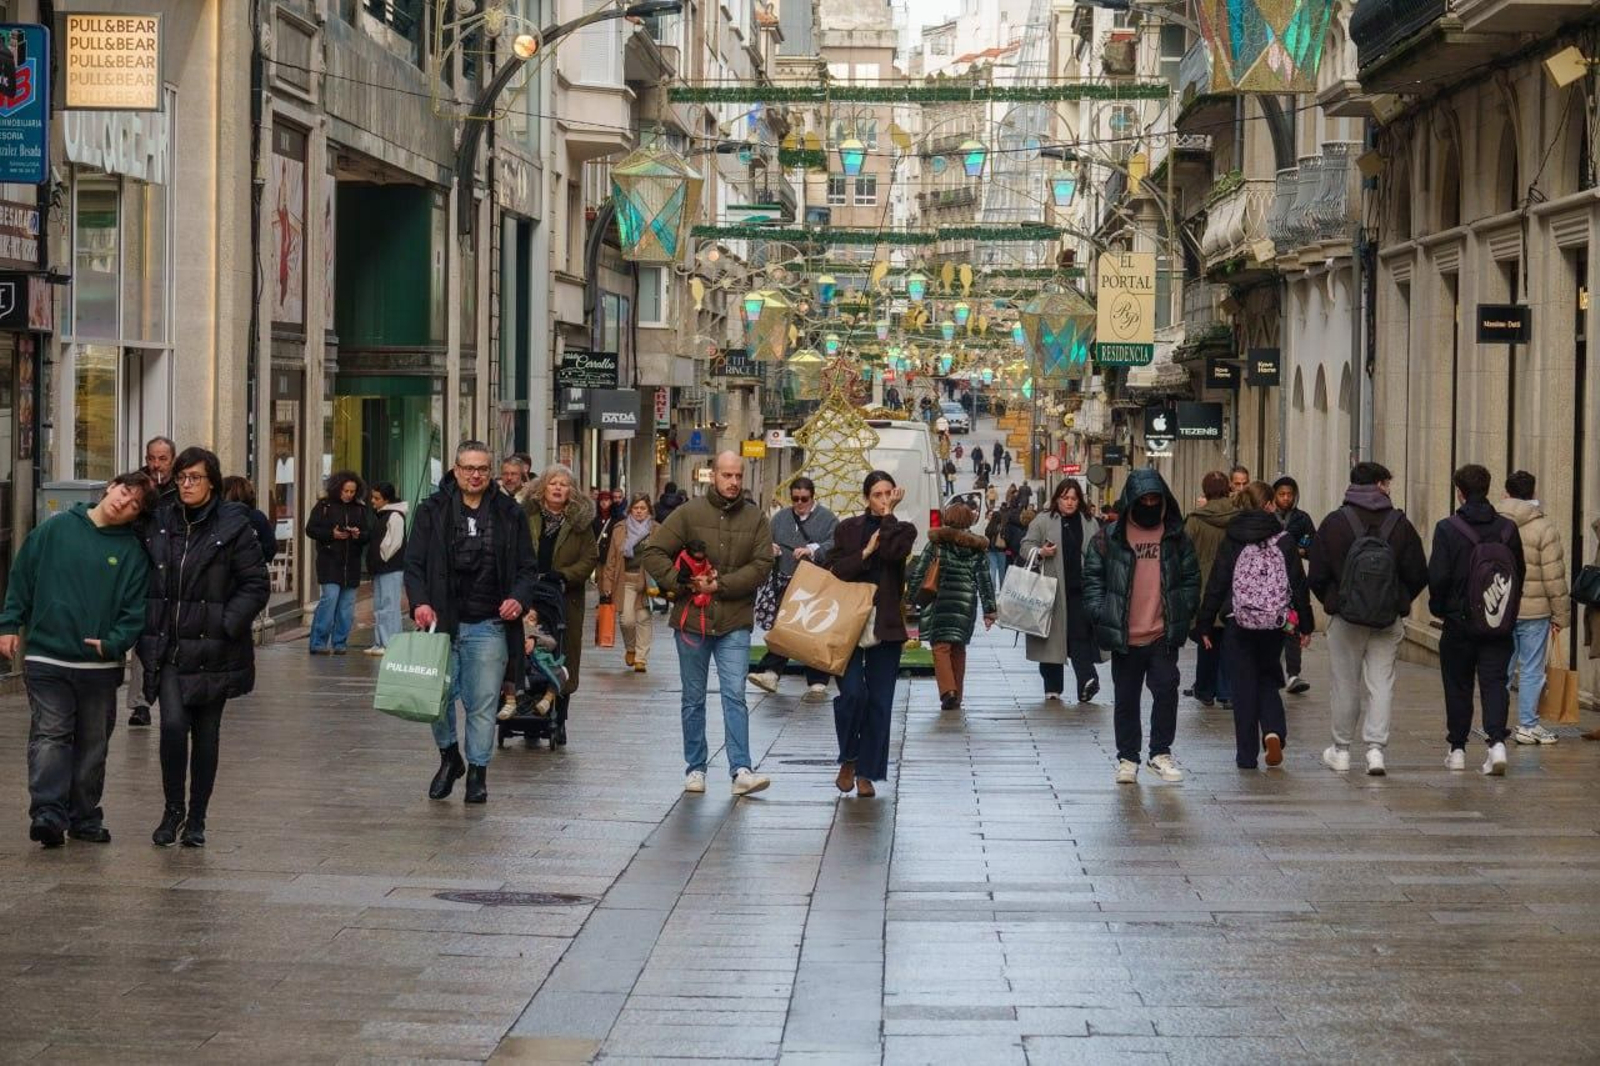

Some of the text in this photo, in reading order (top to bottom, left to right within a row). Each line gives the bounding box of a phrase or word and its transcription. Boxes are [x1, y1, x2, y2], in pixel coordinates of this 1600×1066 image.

[70, 19, 156, 33] PULL&BEAR
[70, 37, 156, 50] PULL&BEAR
[70, 55, 156, 68] PULL&BEAR
[70, 72, 156, 86] PULL&BEAR
[1120, 255, 1135, 268] EL
[1101, 275, 1152, 289] PORTAL
[1101, 345, 1149, 361] RESIDENCIA
[385, 661, 439, 677] PULL&BEAR
